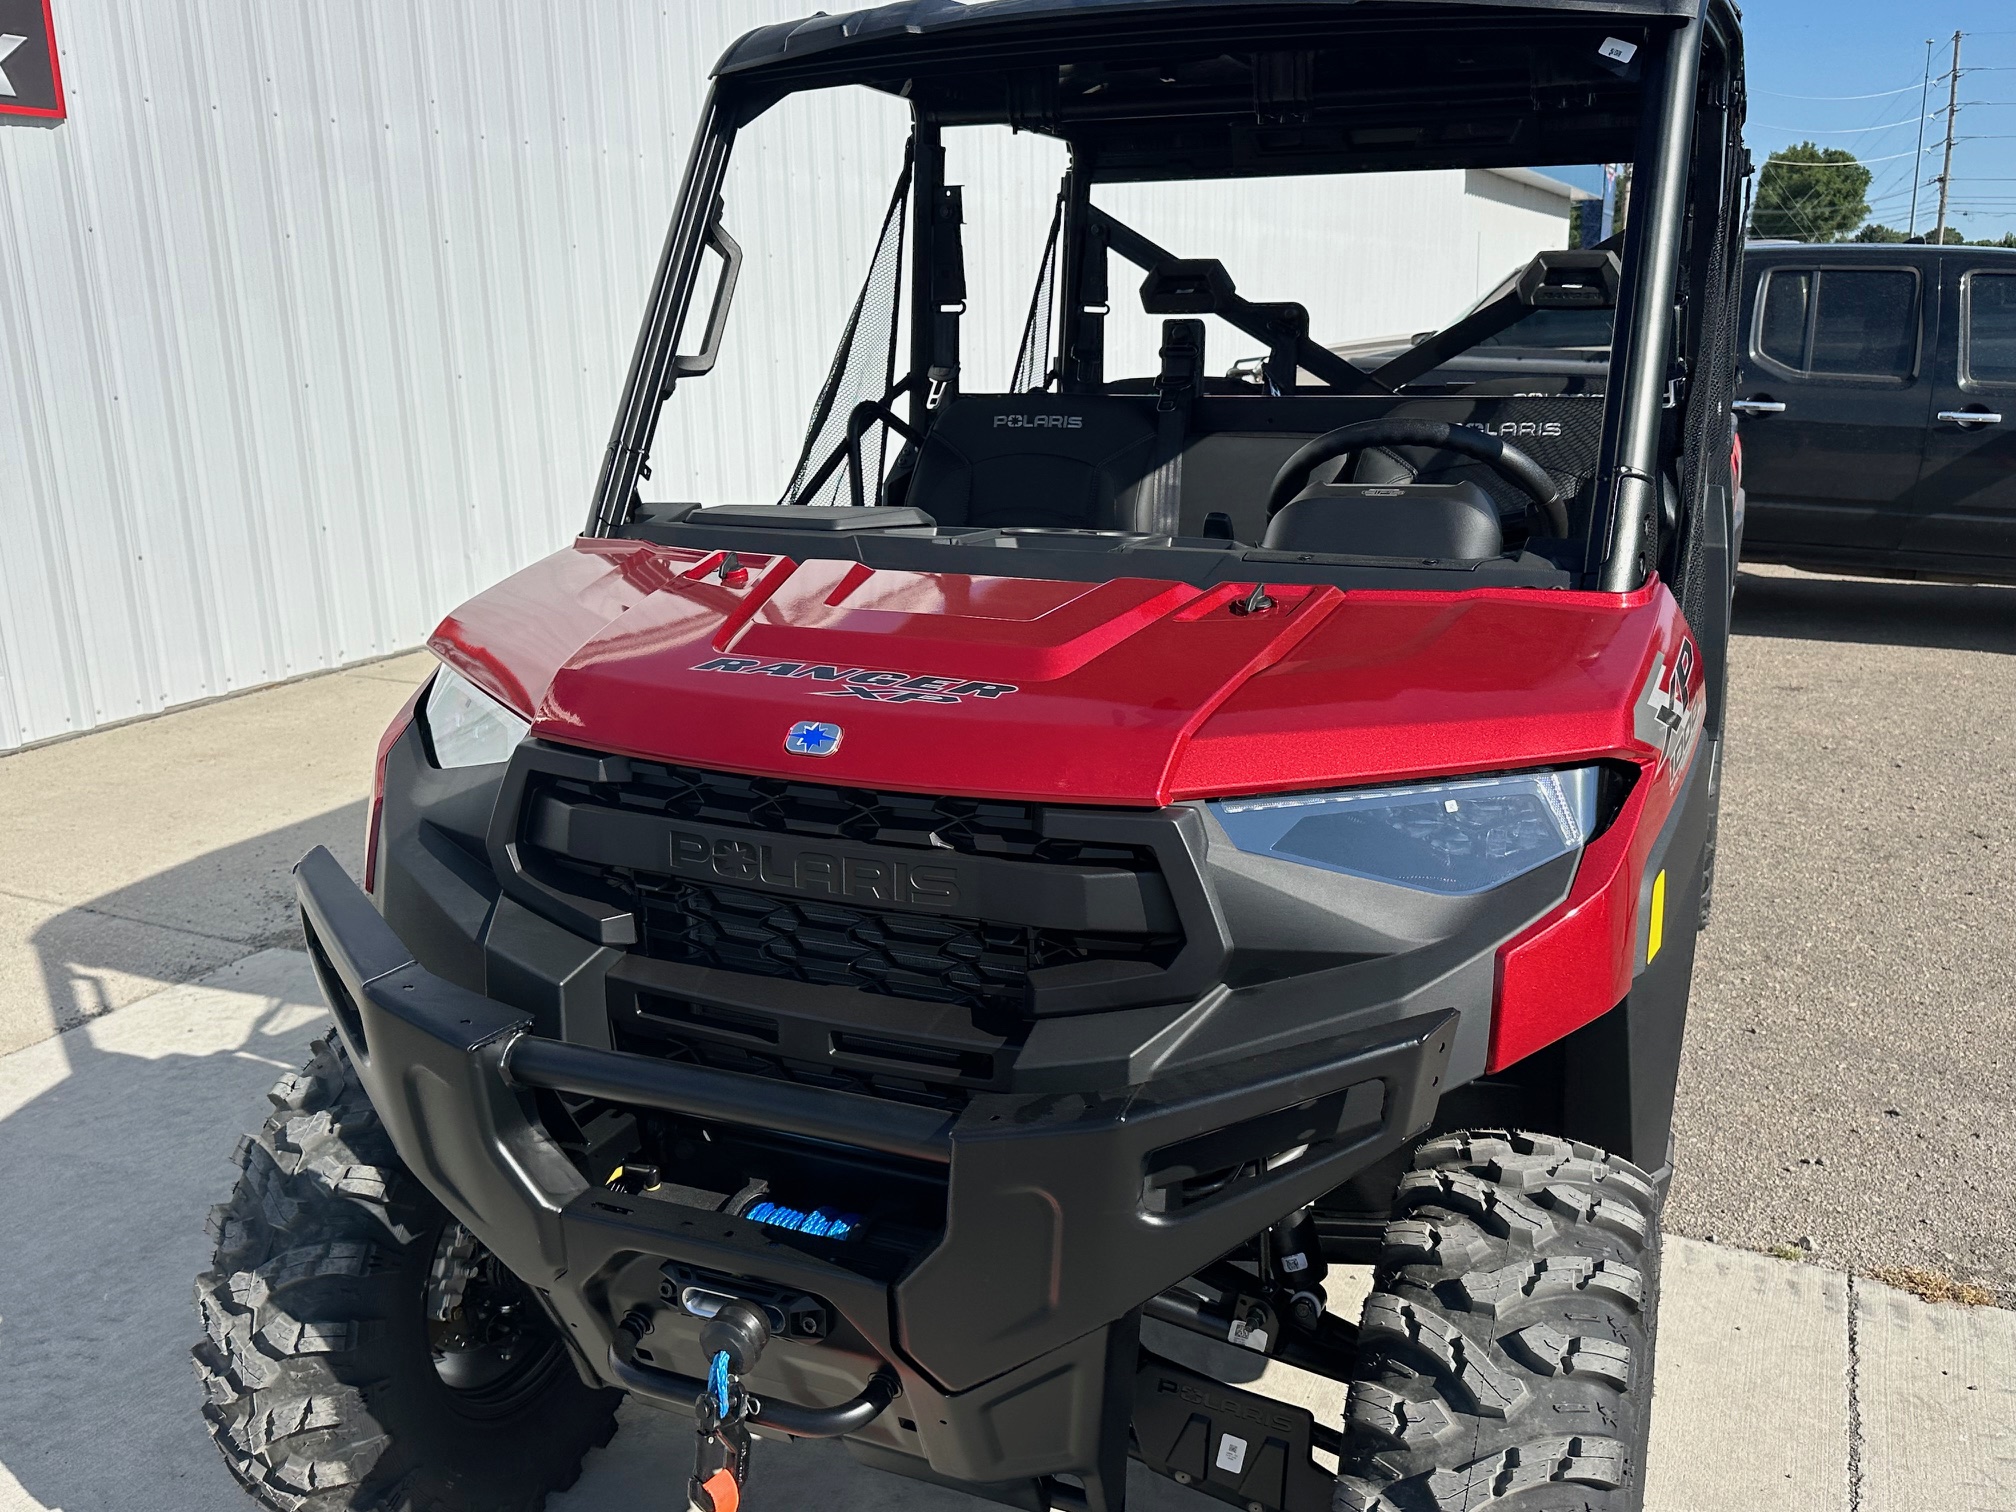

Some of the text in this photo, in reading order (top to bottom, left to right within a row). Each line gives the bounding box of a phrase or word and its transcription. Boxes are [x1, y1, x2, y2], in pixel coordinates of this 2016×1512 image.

[993, 415, 1083, 429] POLARIS
[688, 657, 1019, 700] RANGER
[805, 684, 963, 704] XP
[669, 830, 962, 907] POLARIS
[1157, 1377, 1294, 1433] POLARIS
